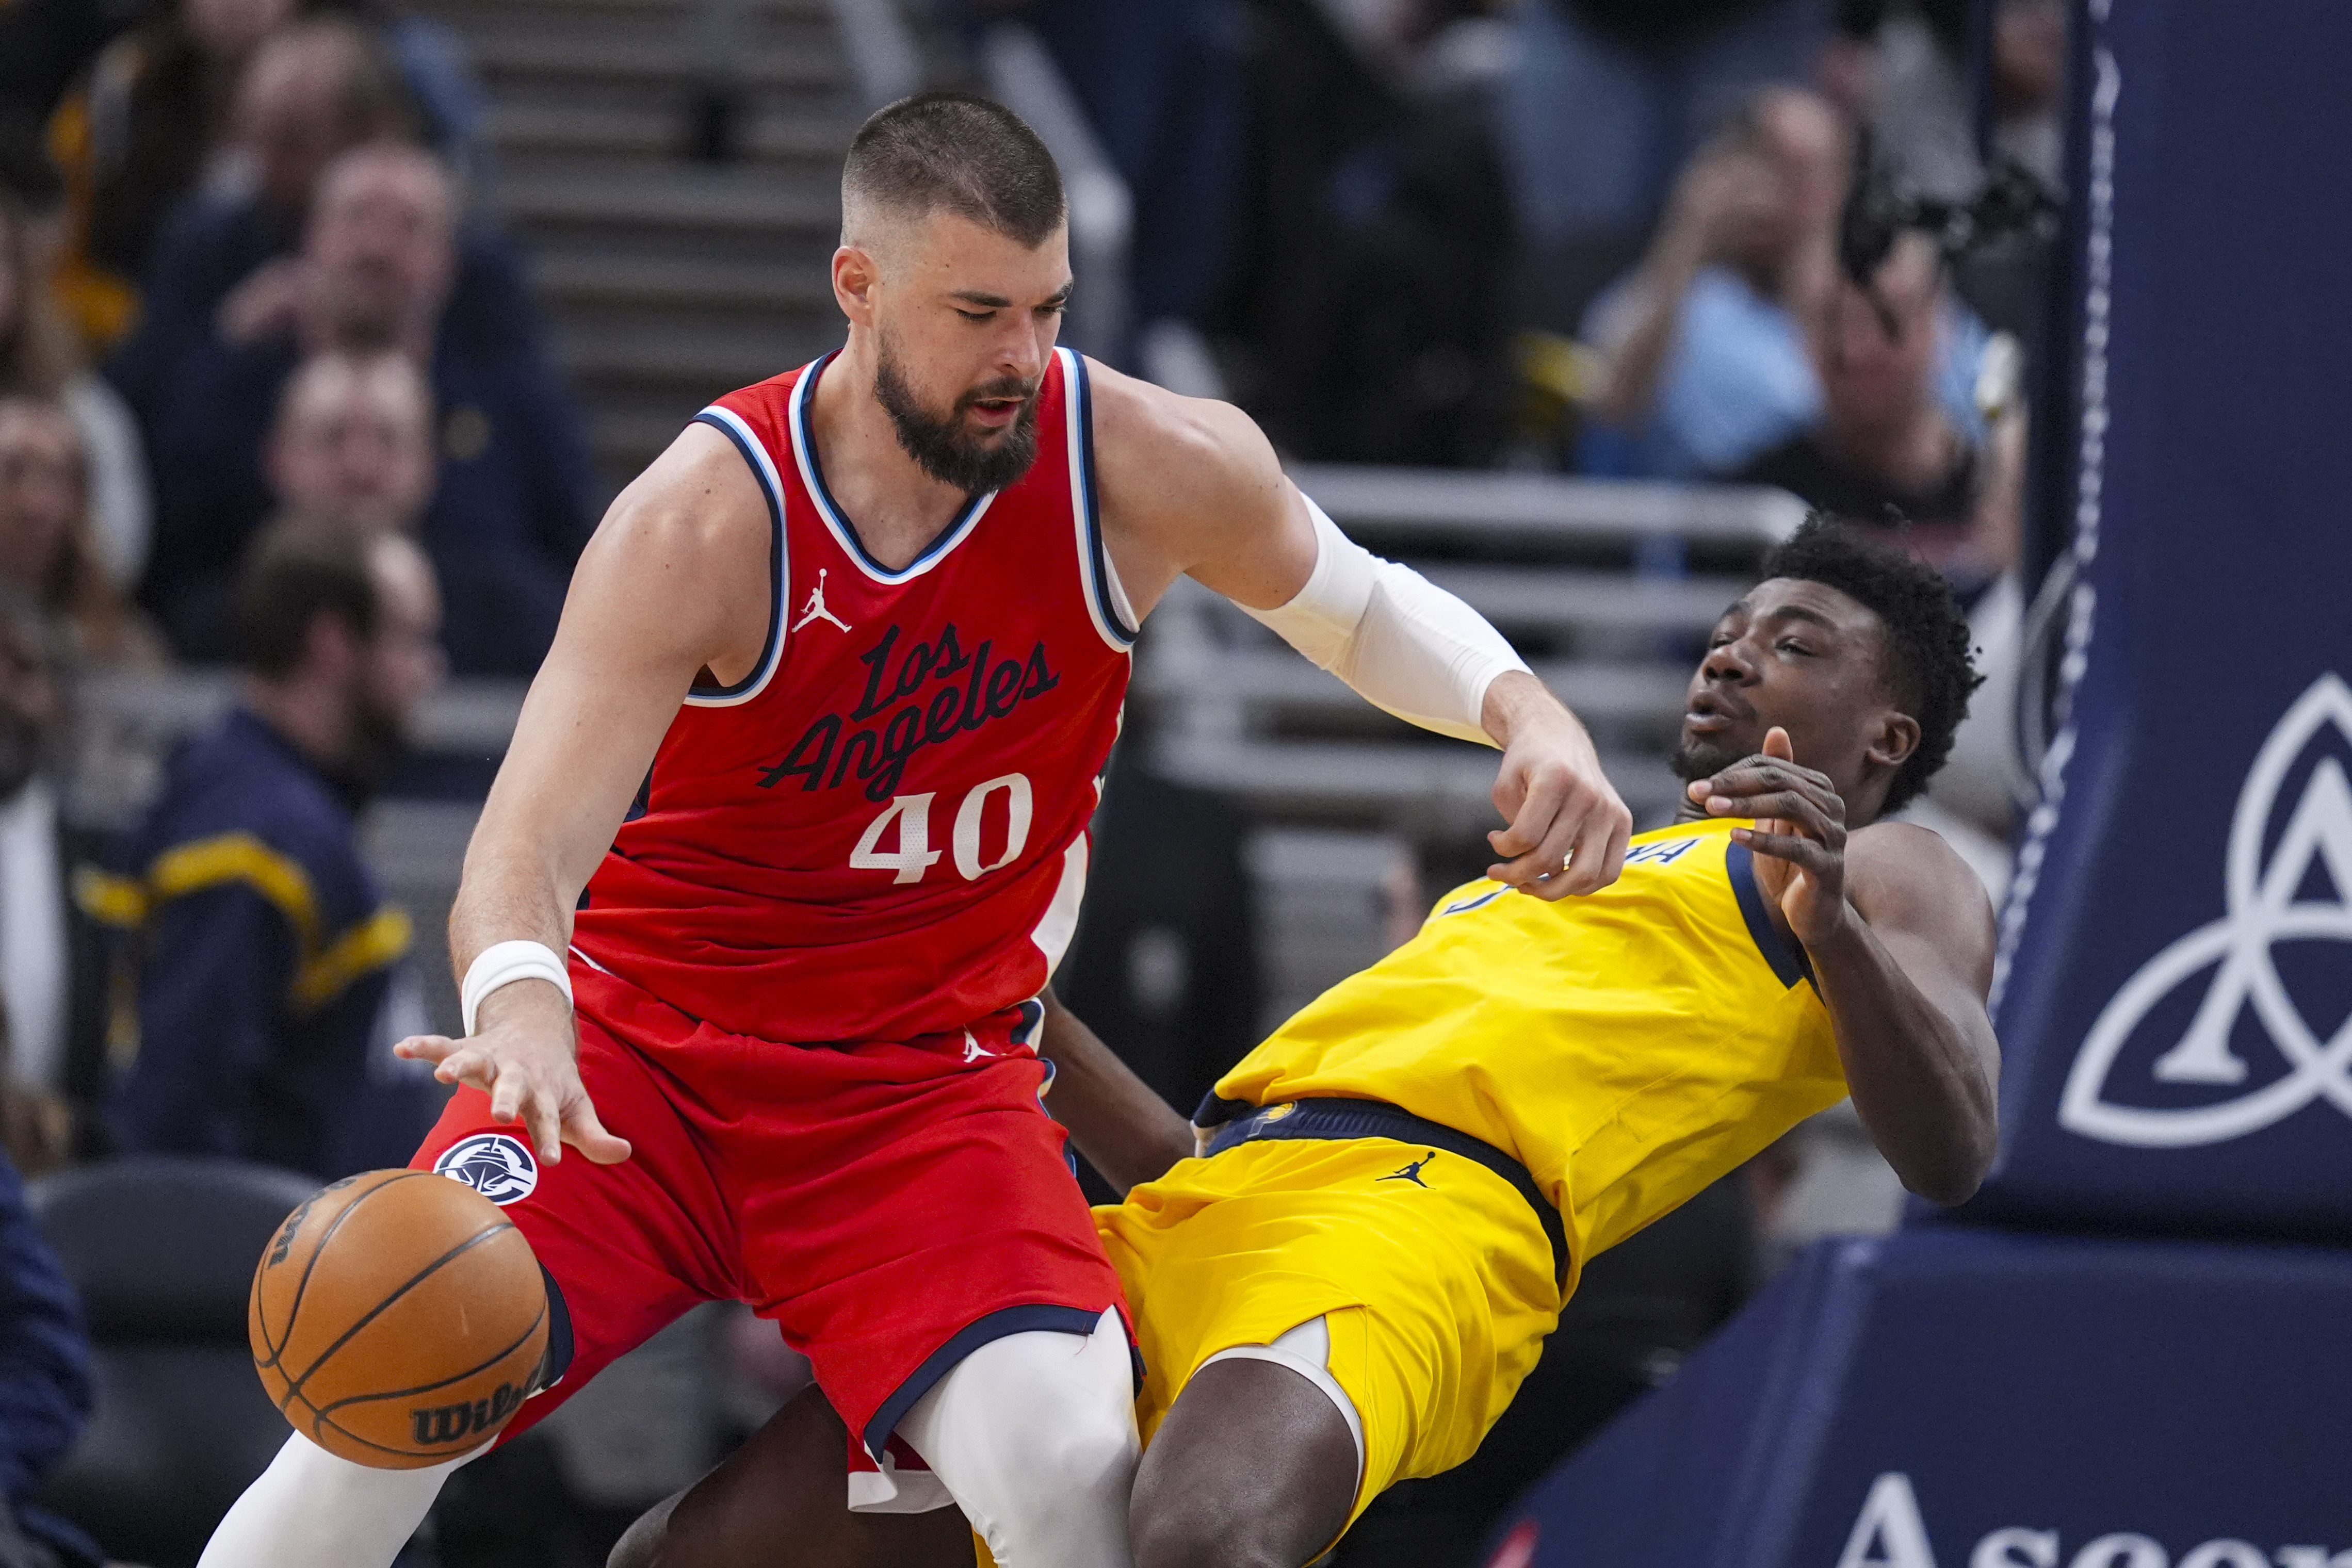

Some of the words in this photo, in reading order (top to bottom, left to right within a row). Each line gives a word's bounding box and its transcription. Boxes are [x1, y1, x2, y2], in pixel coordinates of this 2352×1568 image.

[755, 639, 1061, 802] Angeles
[850, 623, 971, 722] Los
[849, 772, 1033, 885] 40
[411, 1373, 536, 1445] Wil
